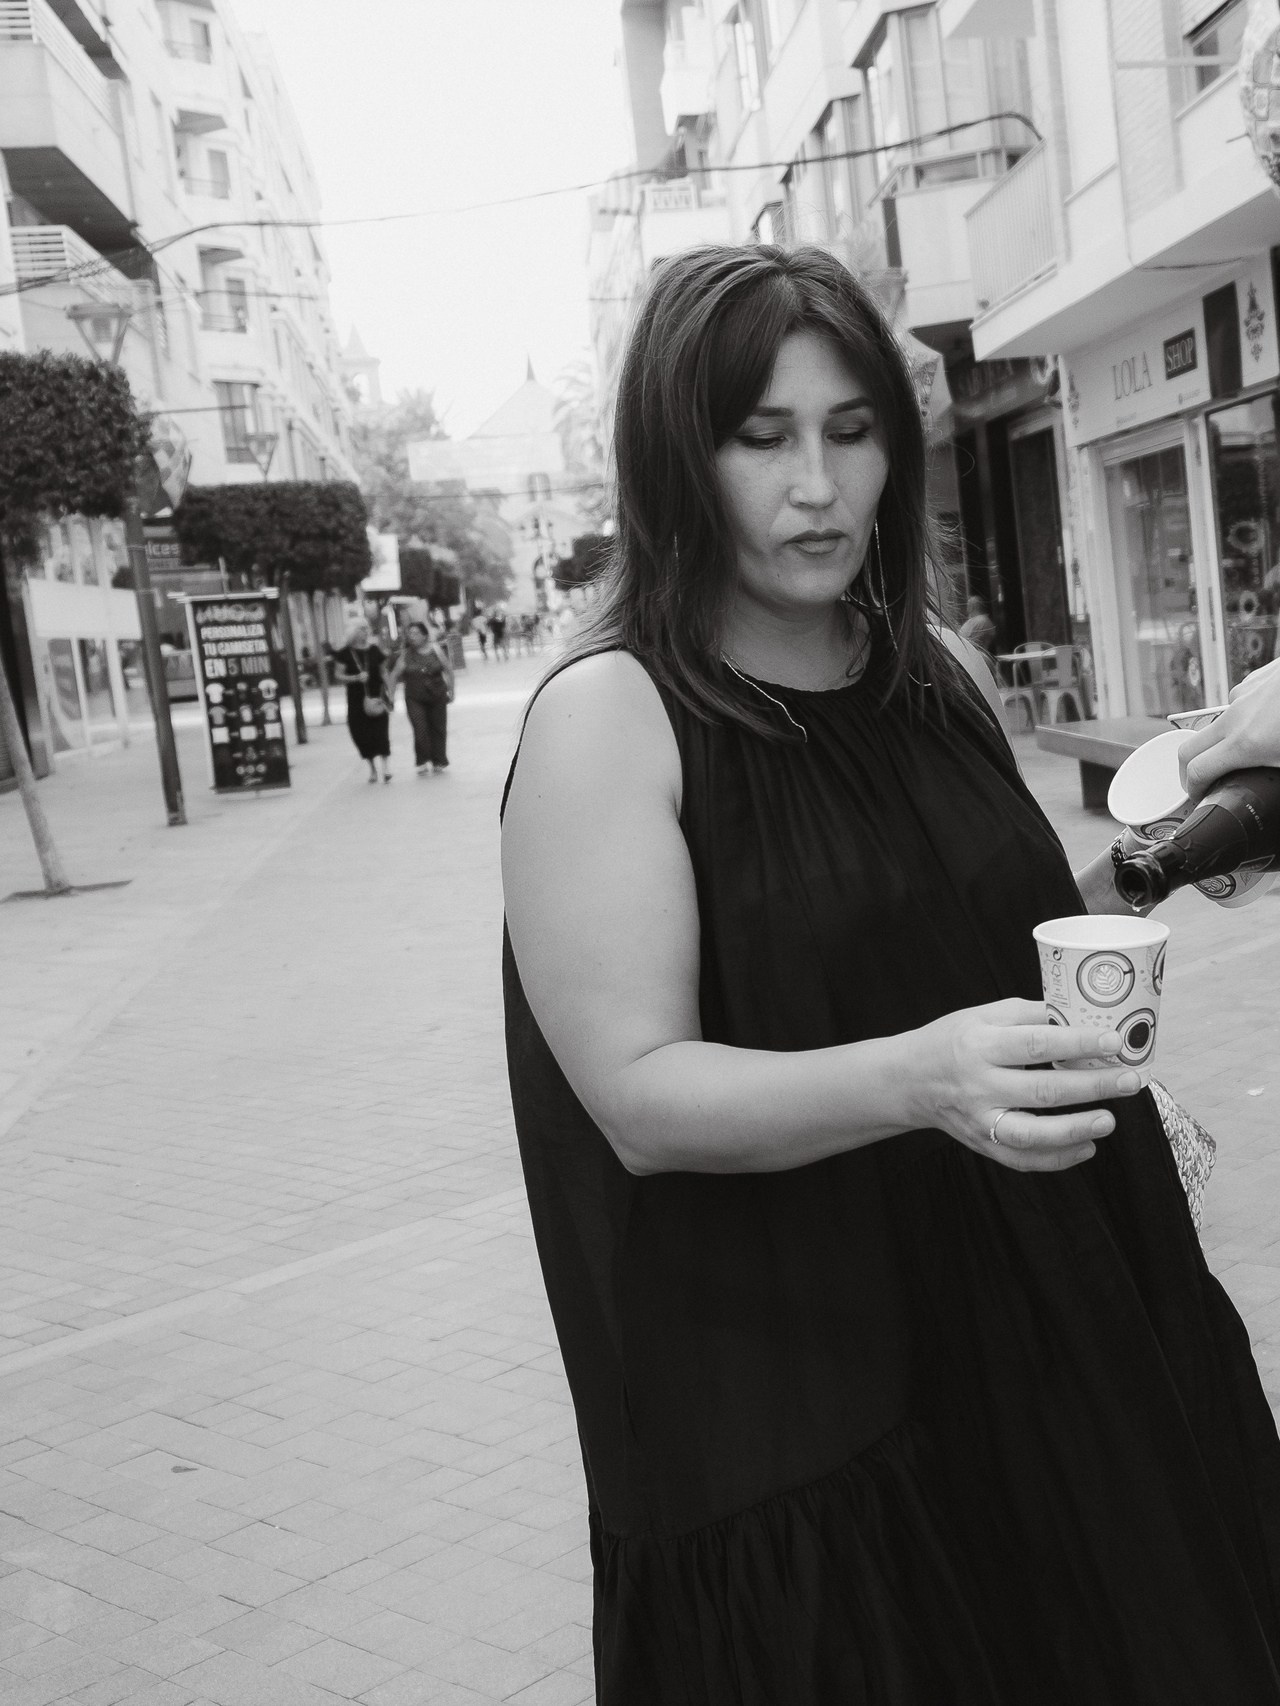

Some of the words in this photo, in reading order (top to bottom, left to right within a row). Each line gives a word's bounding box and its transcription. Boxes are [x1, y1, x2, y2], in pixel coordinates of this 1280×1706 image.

[1112, 351, 1153, 400] LOLA
[1166, 338, 1194, 372] SHOP
[202, 642, 218, 657] TU
[217, 639, 269, 656] CAMISETA
[204, 658, 228, 679] EN
[227, 658, 240, 676] 5
[240, 655, 271, 675] MIN
